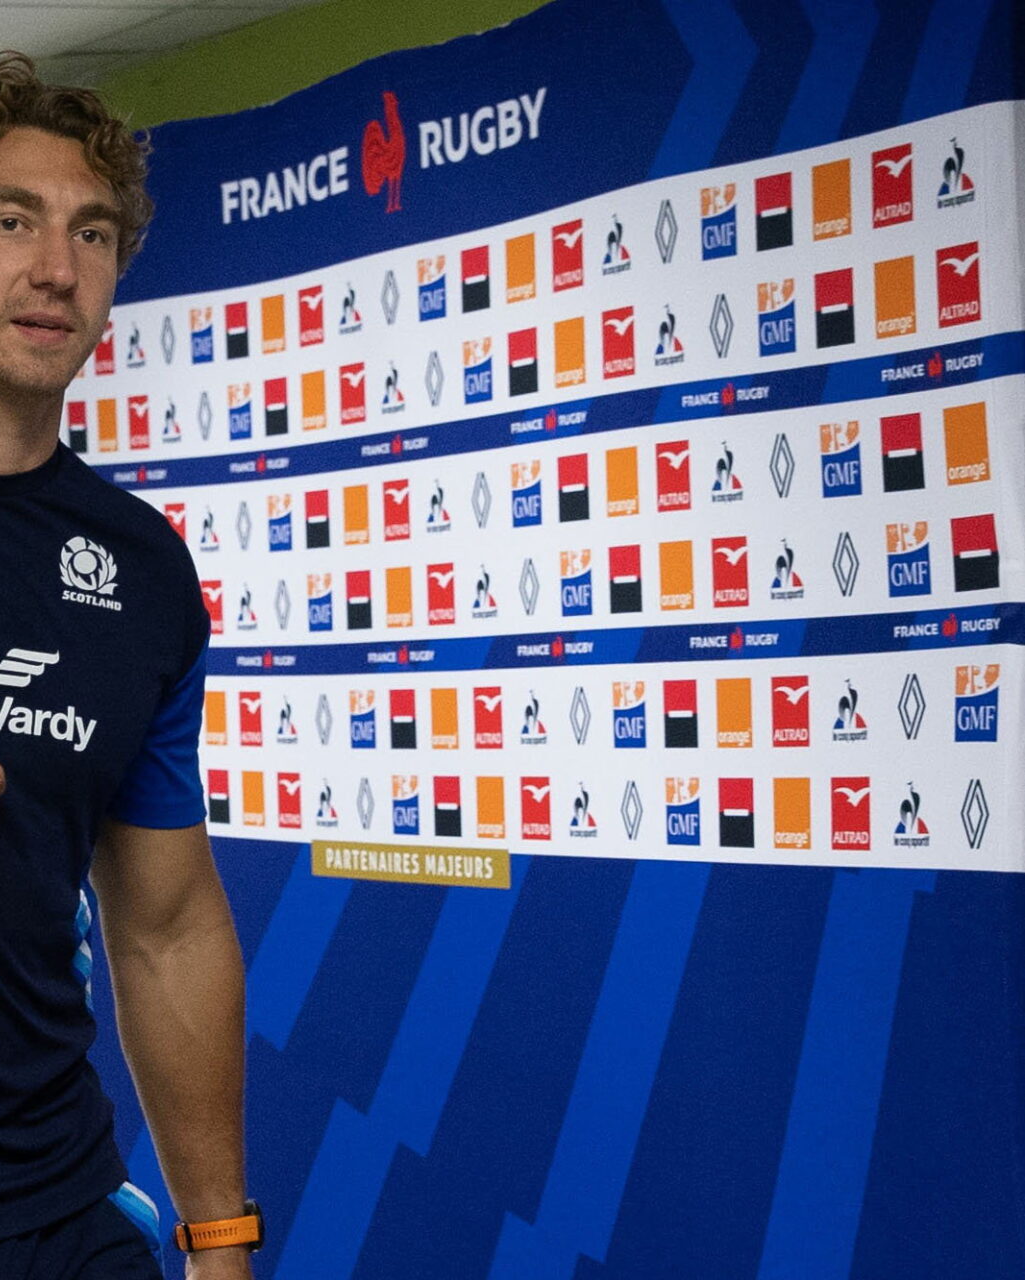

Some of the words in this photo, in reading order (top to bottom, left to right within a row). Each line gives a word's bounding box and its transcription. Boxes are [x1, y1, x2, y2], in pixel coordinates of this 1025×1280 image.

[220, 147, 349, 224] FRANCE
[419, 87, 547, 169] RUGBY
[874, 202, 910, 221] ALTRAD
[703, 222, 734, 249] GMF
[815, 219, 849, 236] orange
[938, 301, 979, 320] ALTRAD
[761, 319, 793, 345] GMF
[877, 316, 914, 334] orange
[881, 364, 924, 382] FRANCE
[945, 353, 983, 372] RUGBY
[681, 392, 719, 408] FRANCE
[737, 386, 769, 401] RUGBY
[511, 418, 543, 434] FRANCE
[558, 411, 587, 426] RUGBY
[824, 461, 860, 488] GMF
[948, 462, 989, 480] orange
[513, 495, 540, 519] GMF
[890, 560, 928, 587] GMF
[61, 590, 122, 611] SCOTLAND
[562, 584, 591, 607] GMF
[714, 589, 748, 602] ALTRAD
[893, 624, 938, 638] FRANCE
[960, 618, 1000, 633] RUGBY
[517, 644, 550, 658] FRANCE
[564, 642, 594, 656] RUGBY
[690, 636, 728, 650] FRANCE
[745, 633, 779, 647] RUGBY
[616, 717, 644, 738] GMF
[957, 705, 996, 731] GMF
[718, 731, 752, 747] orange
[774, 728, 809, 742] ALTRAD
[668, 815, 699, 837] GMF
[774, 832, 810, 848] orange
[833, 831, 869, 845] ALTRAD
[326, 847, 420, 875] PARTENAIRES
[425, 854, 494, 880] MAJEURS
